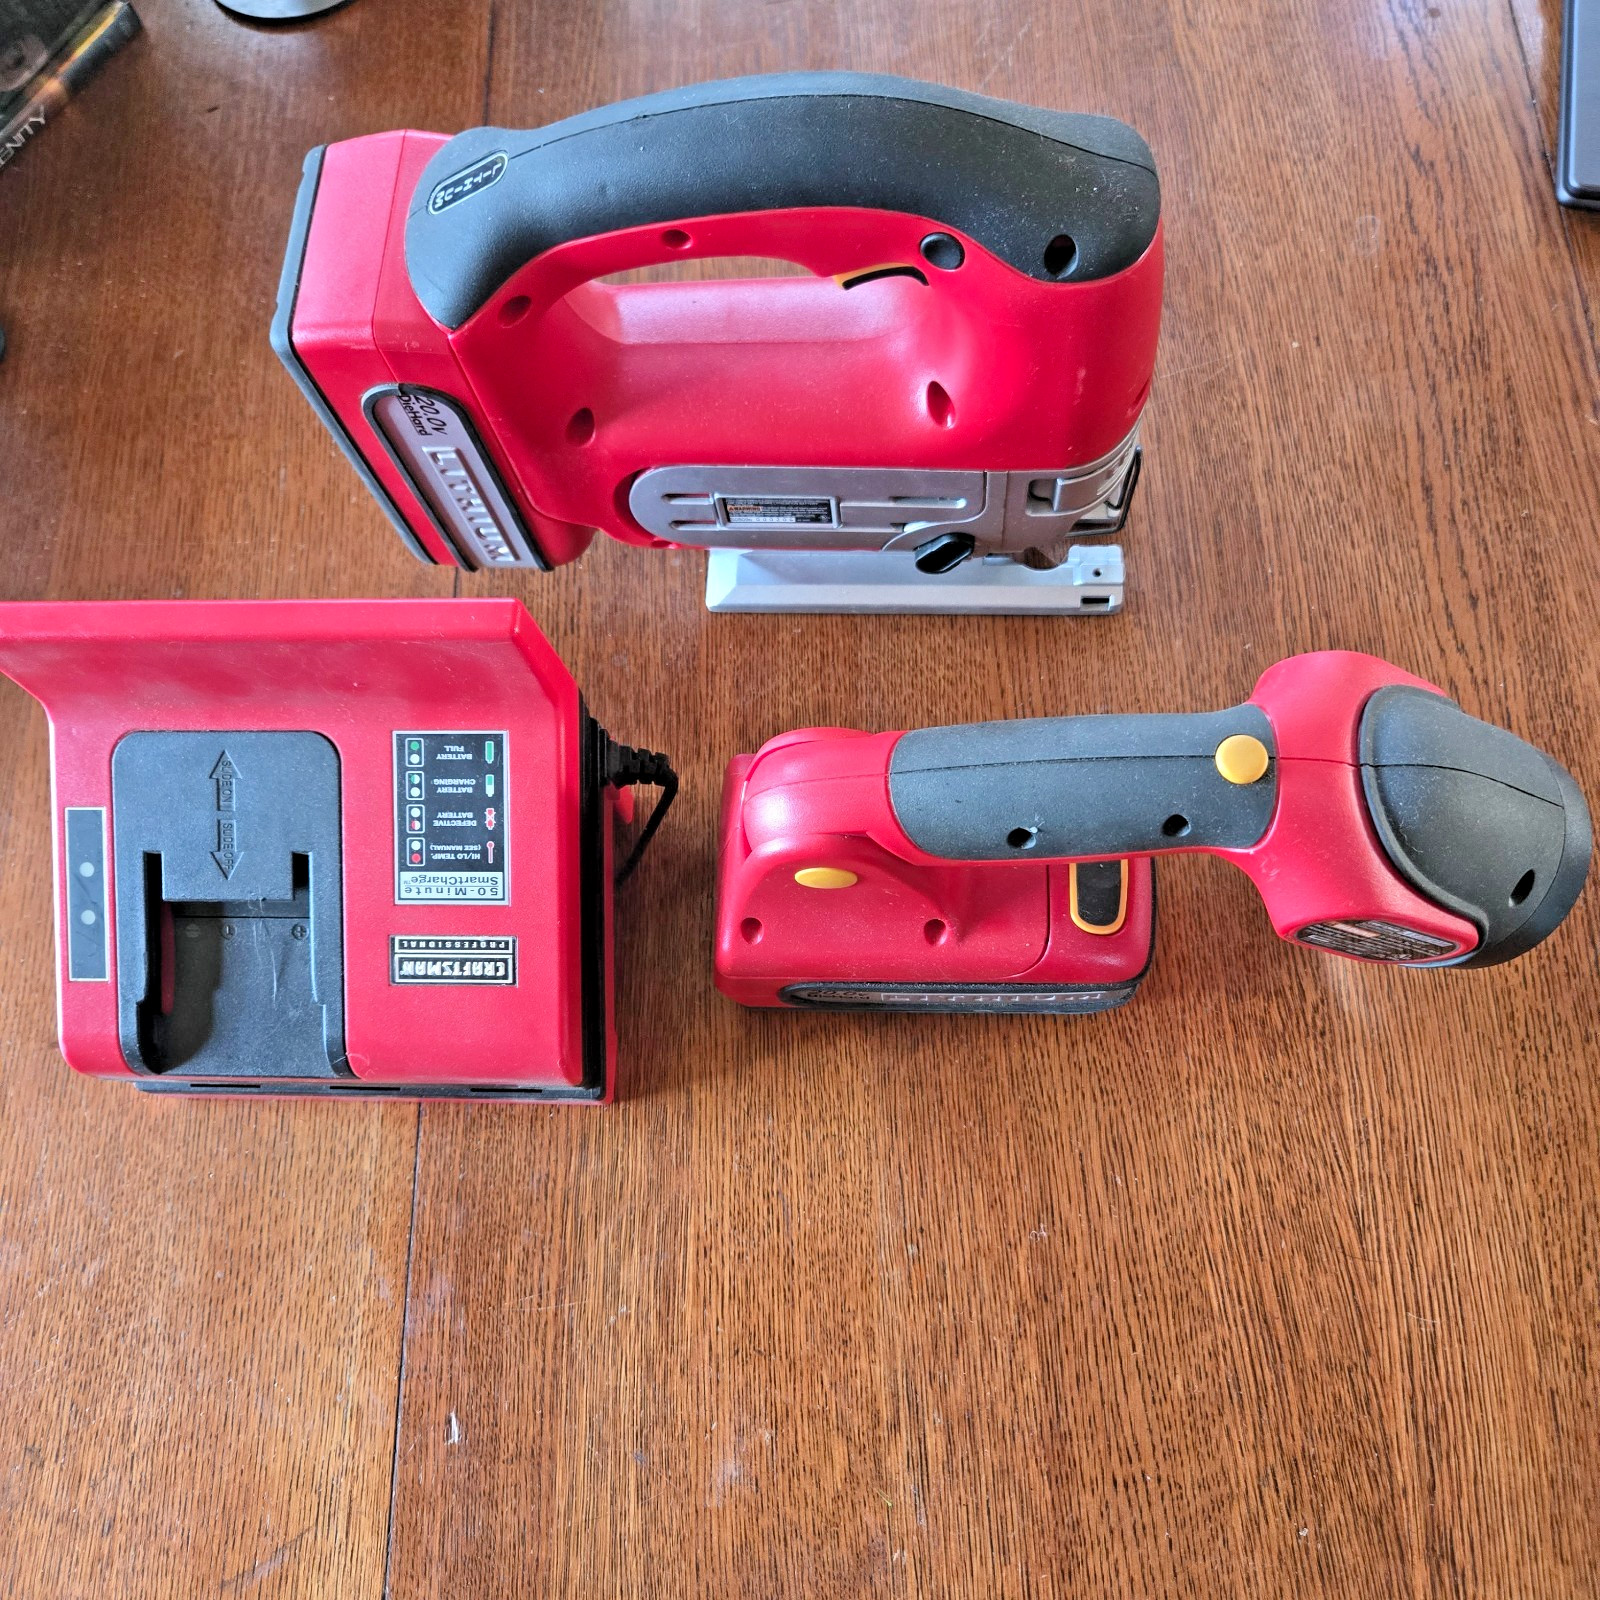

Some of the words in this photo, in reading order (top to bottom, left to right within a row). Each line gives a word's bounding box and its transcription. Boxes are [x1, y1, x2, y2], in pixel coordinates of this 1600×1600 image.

[434, 162, 502, 209] LITHIUM
[398, 394, 433, 437] DieHard
[430, 450, 516, 561] LITHIUM
[221, 760, 232, 787] SLIDE
[433, 778, 476, 786] CHARGING
[222, 790, 233, 803] ON
[436, 786, 473, 794] BATTERY
[436, 811, 473, 819] BATTERY
[222, 823, 234, 850] SLIDE
[429, 844, 463, 852] MANUAL)
[465, 844, 482, 852] (SEE
[223, 852, 234, 870] OFF
[404, 886, 499, 896] 50-Minute
[401, 940, 505, 949] PROFESSIONAL
[400, 960, 506, 977] CRAFTSMAN
